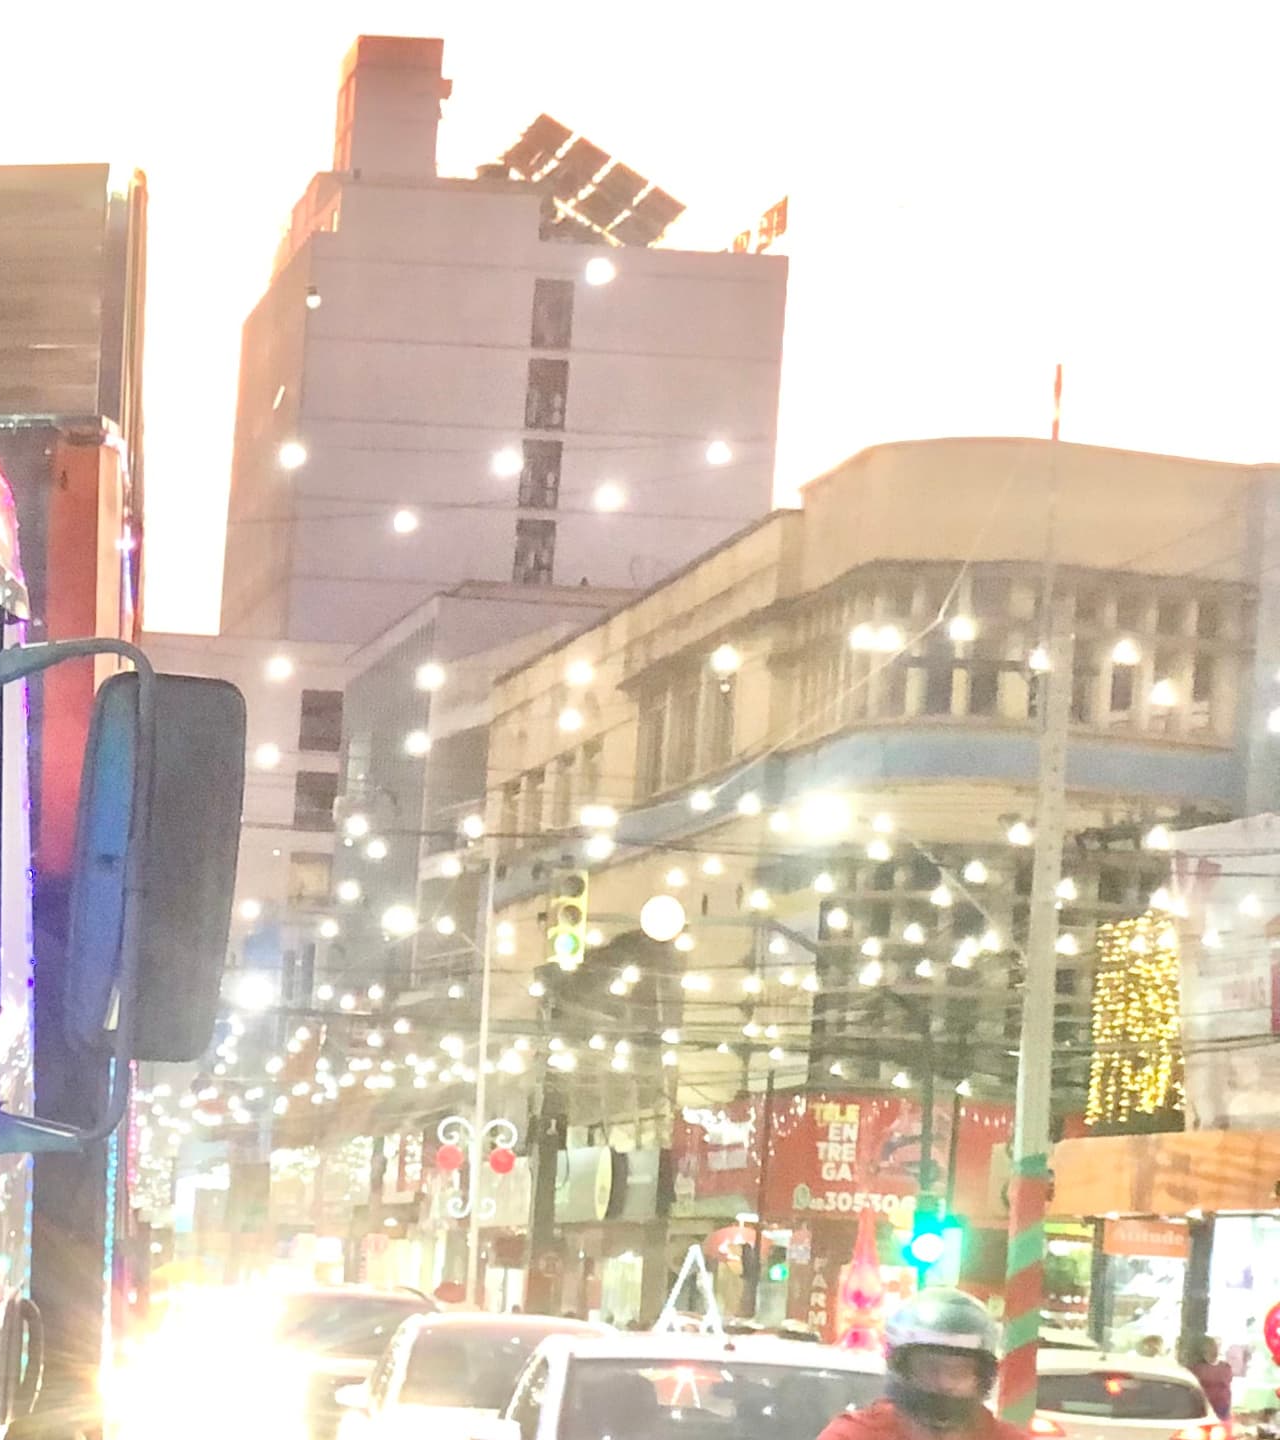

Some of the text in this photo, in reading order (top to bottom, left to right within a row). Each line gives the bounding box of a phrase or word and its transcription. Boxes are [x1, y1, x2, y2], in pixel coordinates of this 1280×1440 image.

[829, 1123, 859, 1142] EN
[816, 1142, 857, 1162] TRE
[821, 1162, 853, 1181] GA
